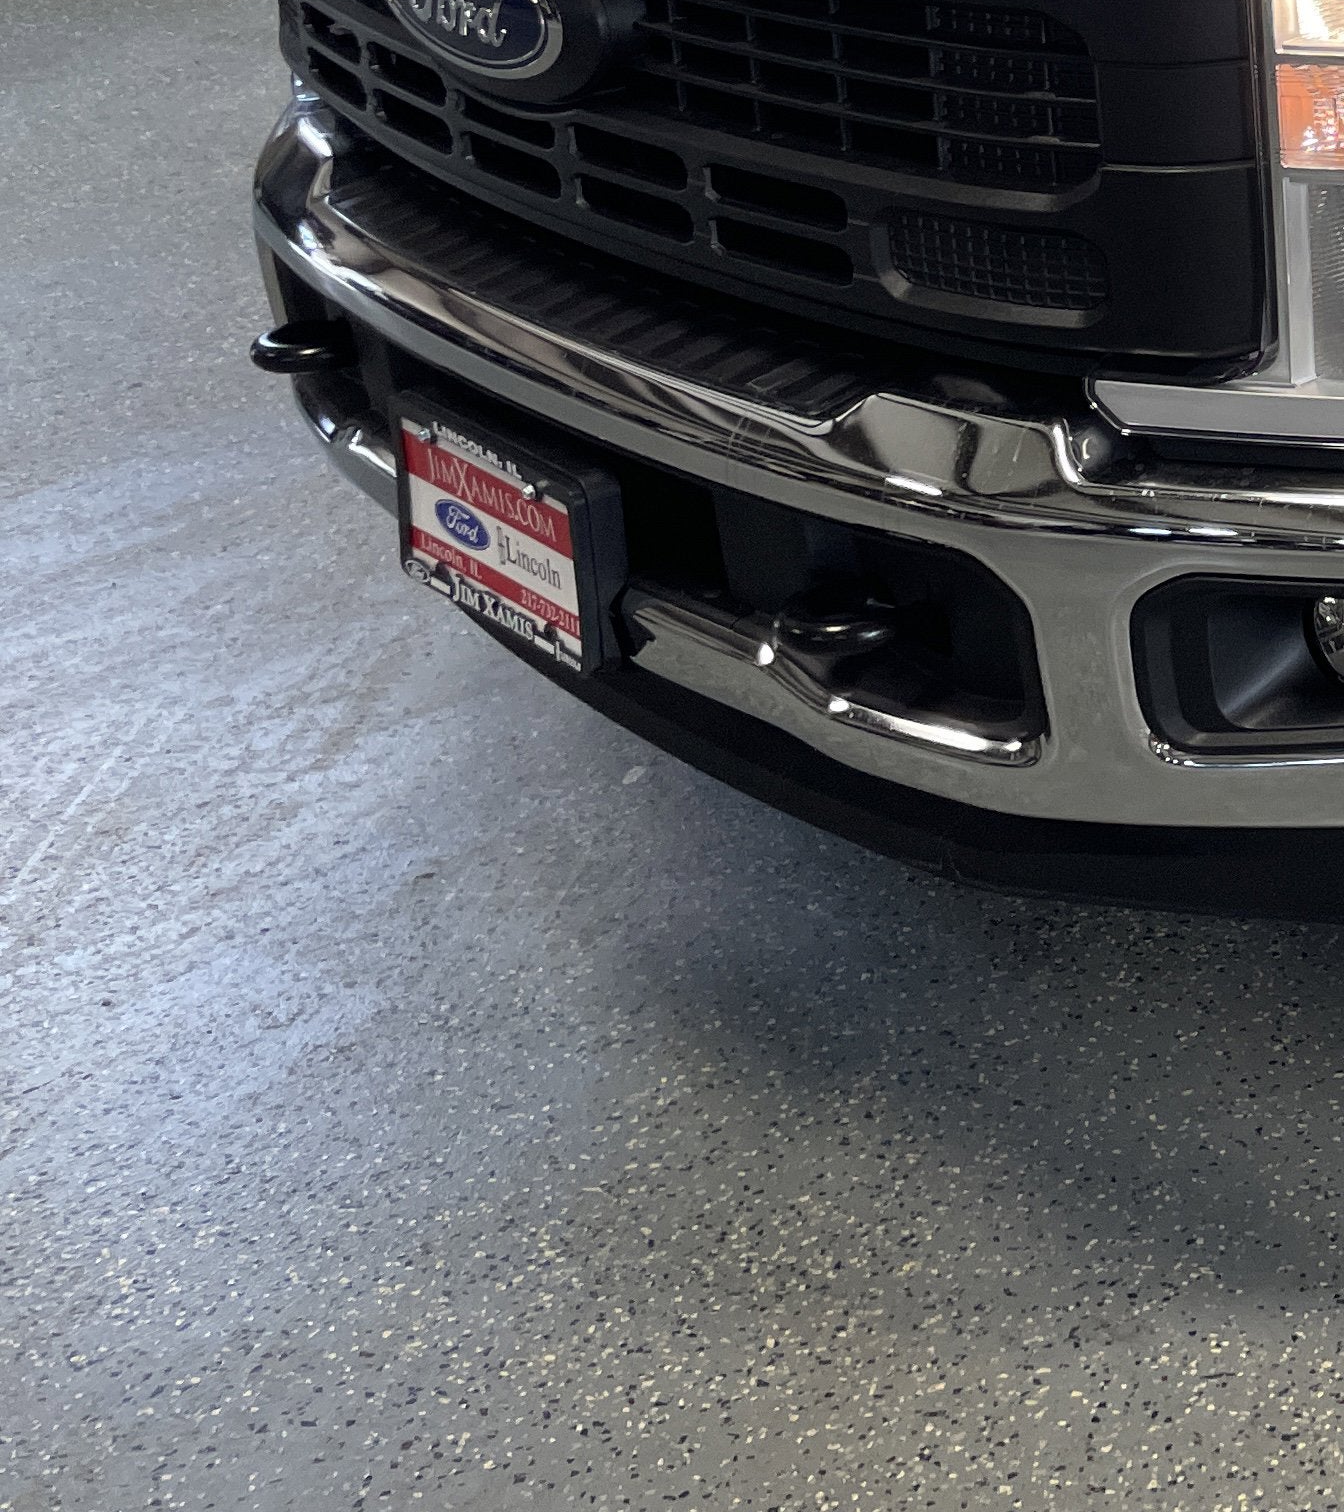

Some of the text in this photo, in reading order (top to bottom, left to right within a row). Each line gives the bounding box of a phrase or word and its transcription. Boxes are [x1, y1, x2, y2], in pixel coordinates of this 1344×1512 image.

[427, 448, 557, 542] JIMXAMIS.COM
[447, 505, 480, 544] Ford
[504, 535, 562, 590] Lincoln
[481, 593, 536, 640] XAMIS
